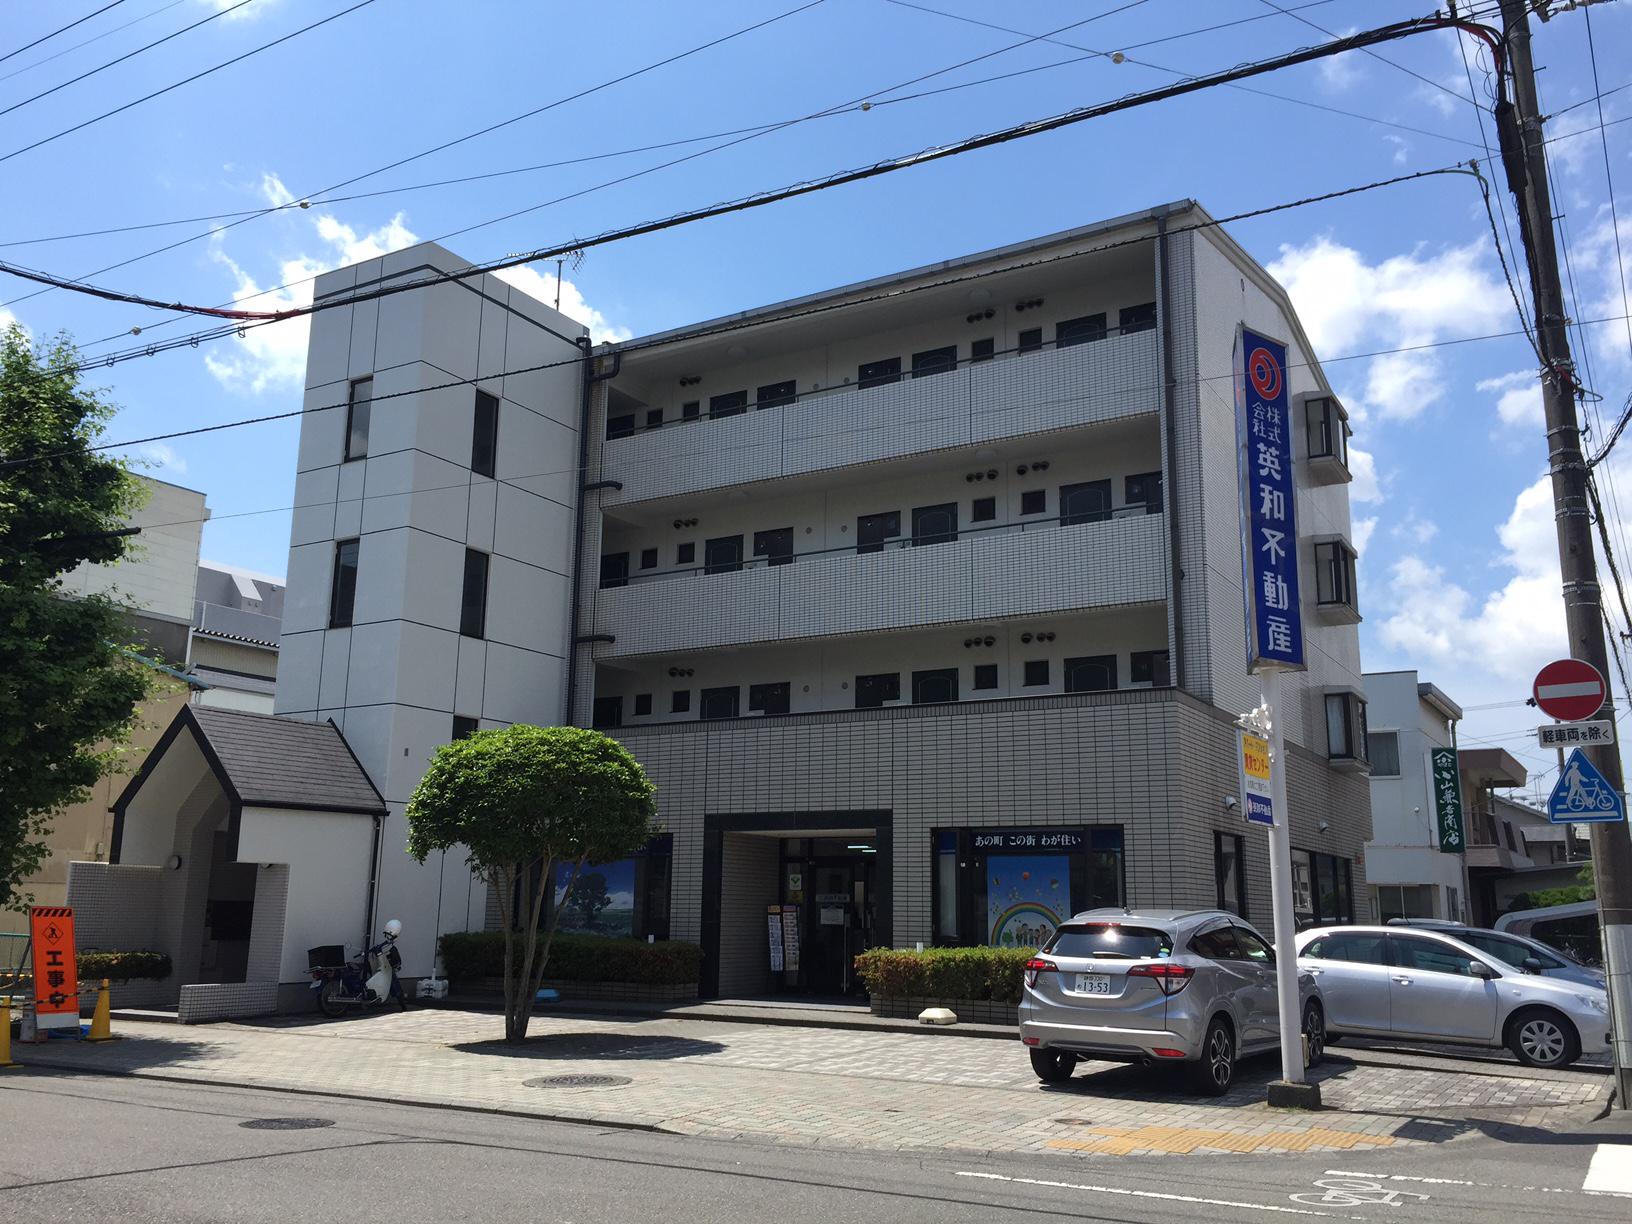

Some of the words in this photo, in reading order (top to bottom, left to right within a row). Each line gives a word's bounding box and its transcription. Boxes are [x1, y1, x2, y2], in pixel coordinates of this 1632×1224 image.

[1257, 442, 1292, 653] 英和不動産
[1542, 726, 1610, 744] 軽車両を除く
[975, 835, 1003, 847] あの町
[1009, 834, 1036, 847] この街
[1041, 834, 1081, 846] わが住い
[46, 950, 65, 1009] 工事中
[1083, 981, 1109, 993] 13-53
